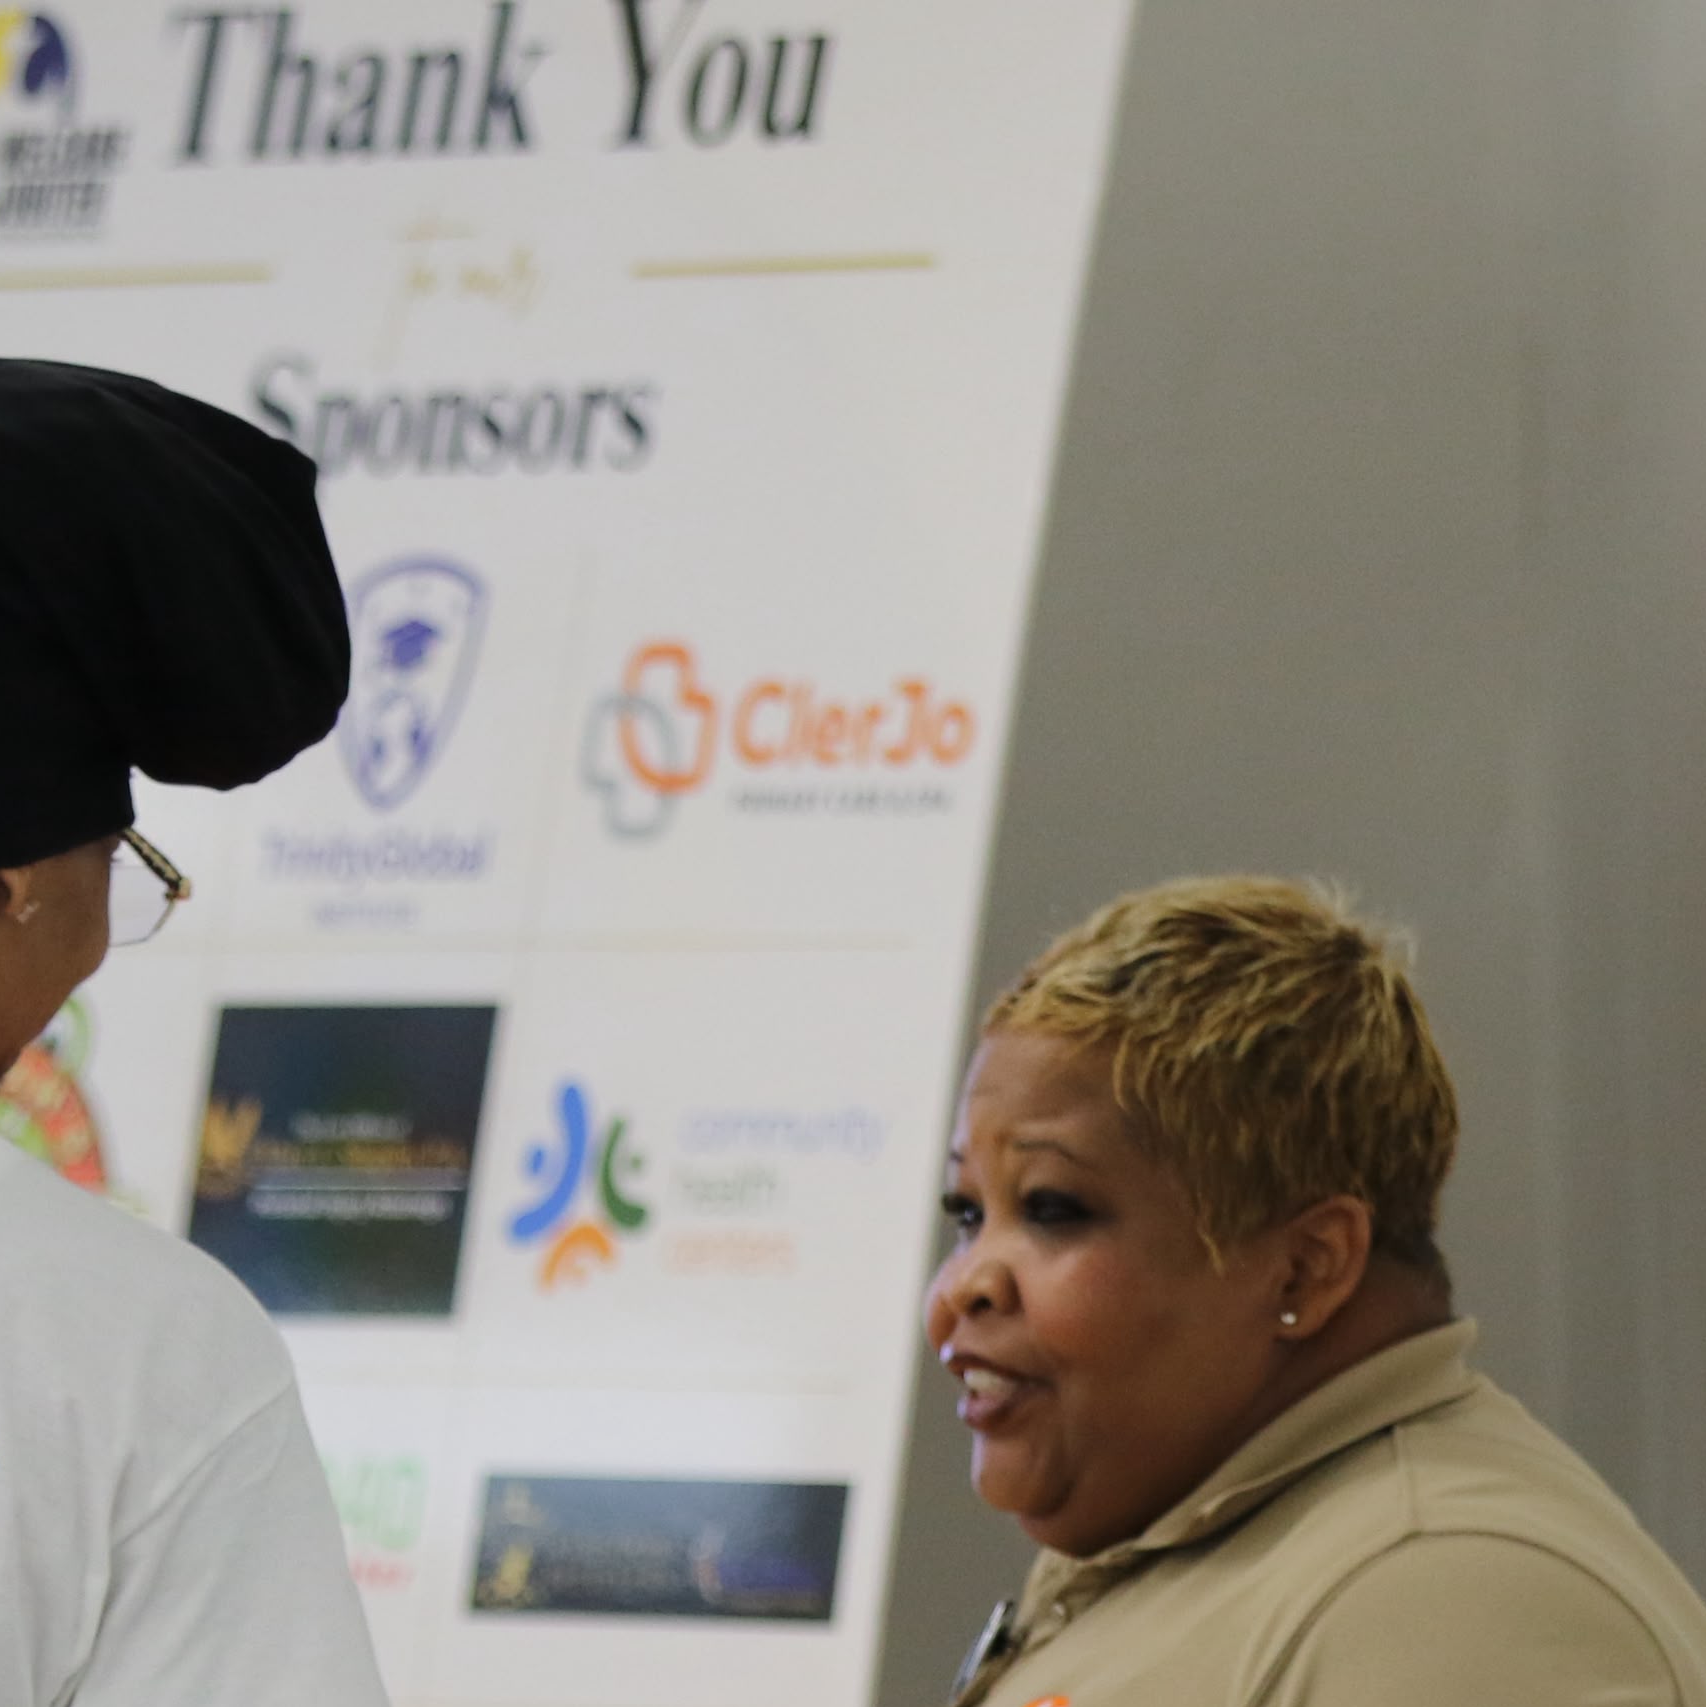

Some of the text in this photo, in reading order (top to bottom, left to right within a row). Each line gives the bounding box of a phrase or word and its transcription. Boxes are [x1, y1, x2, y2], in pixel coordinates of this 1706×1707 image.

[169, 0, 831, 166] Thank You
[251, 352, 662, 478] Sponsors
